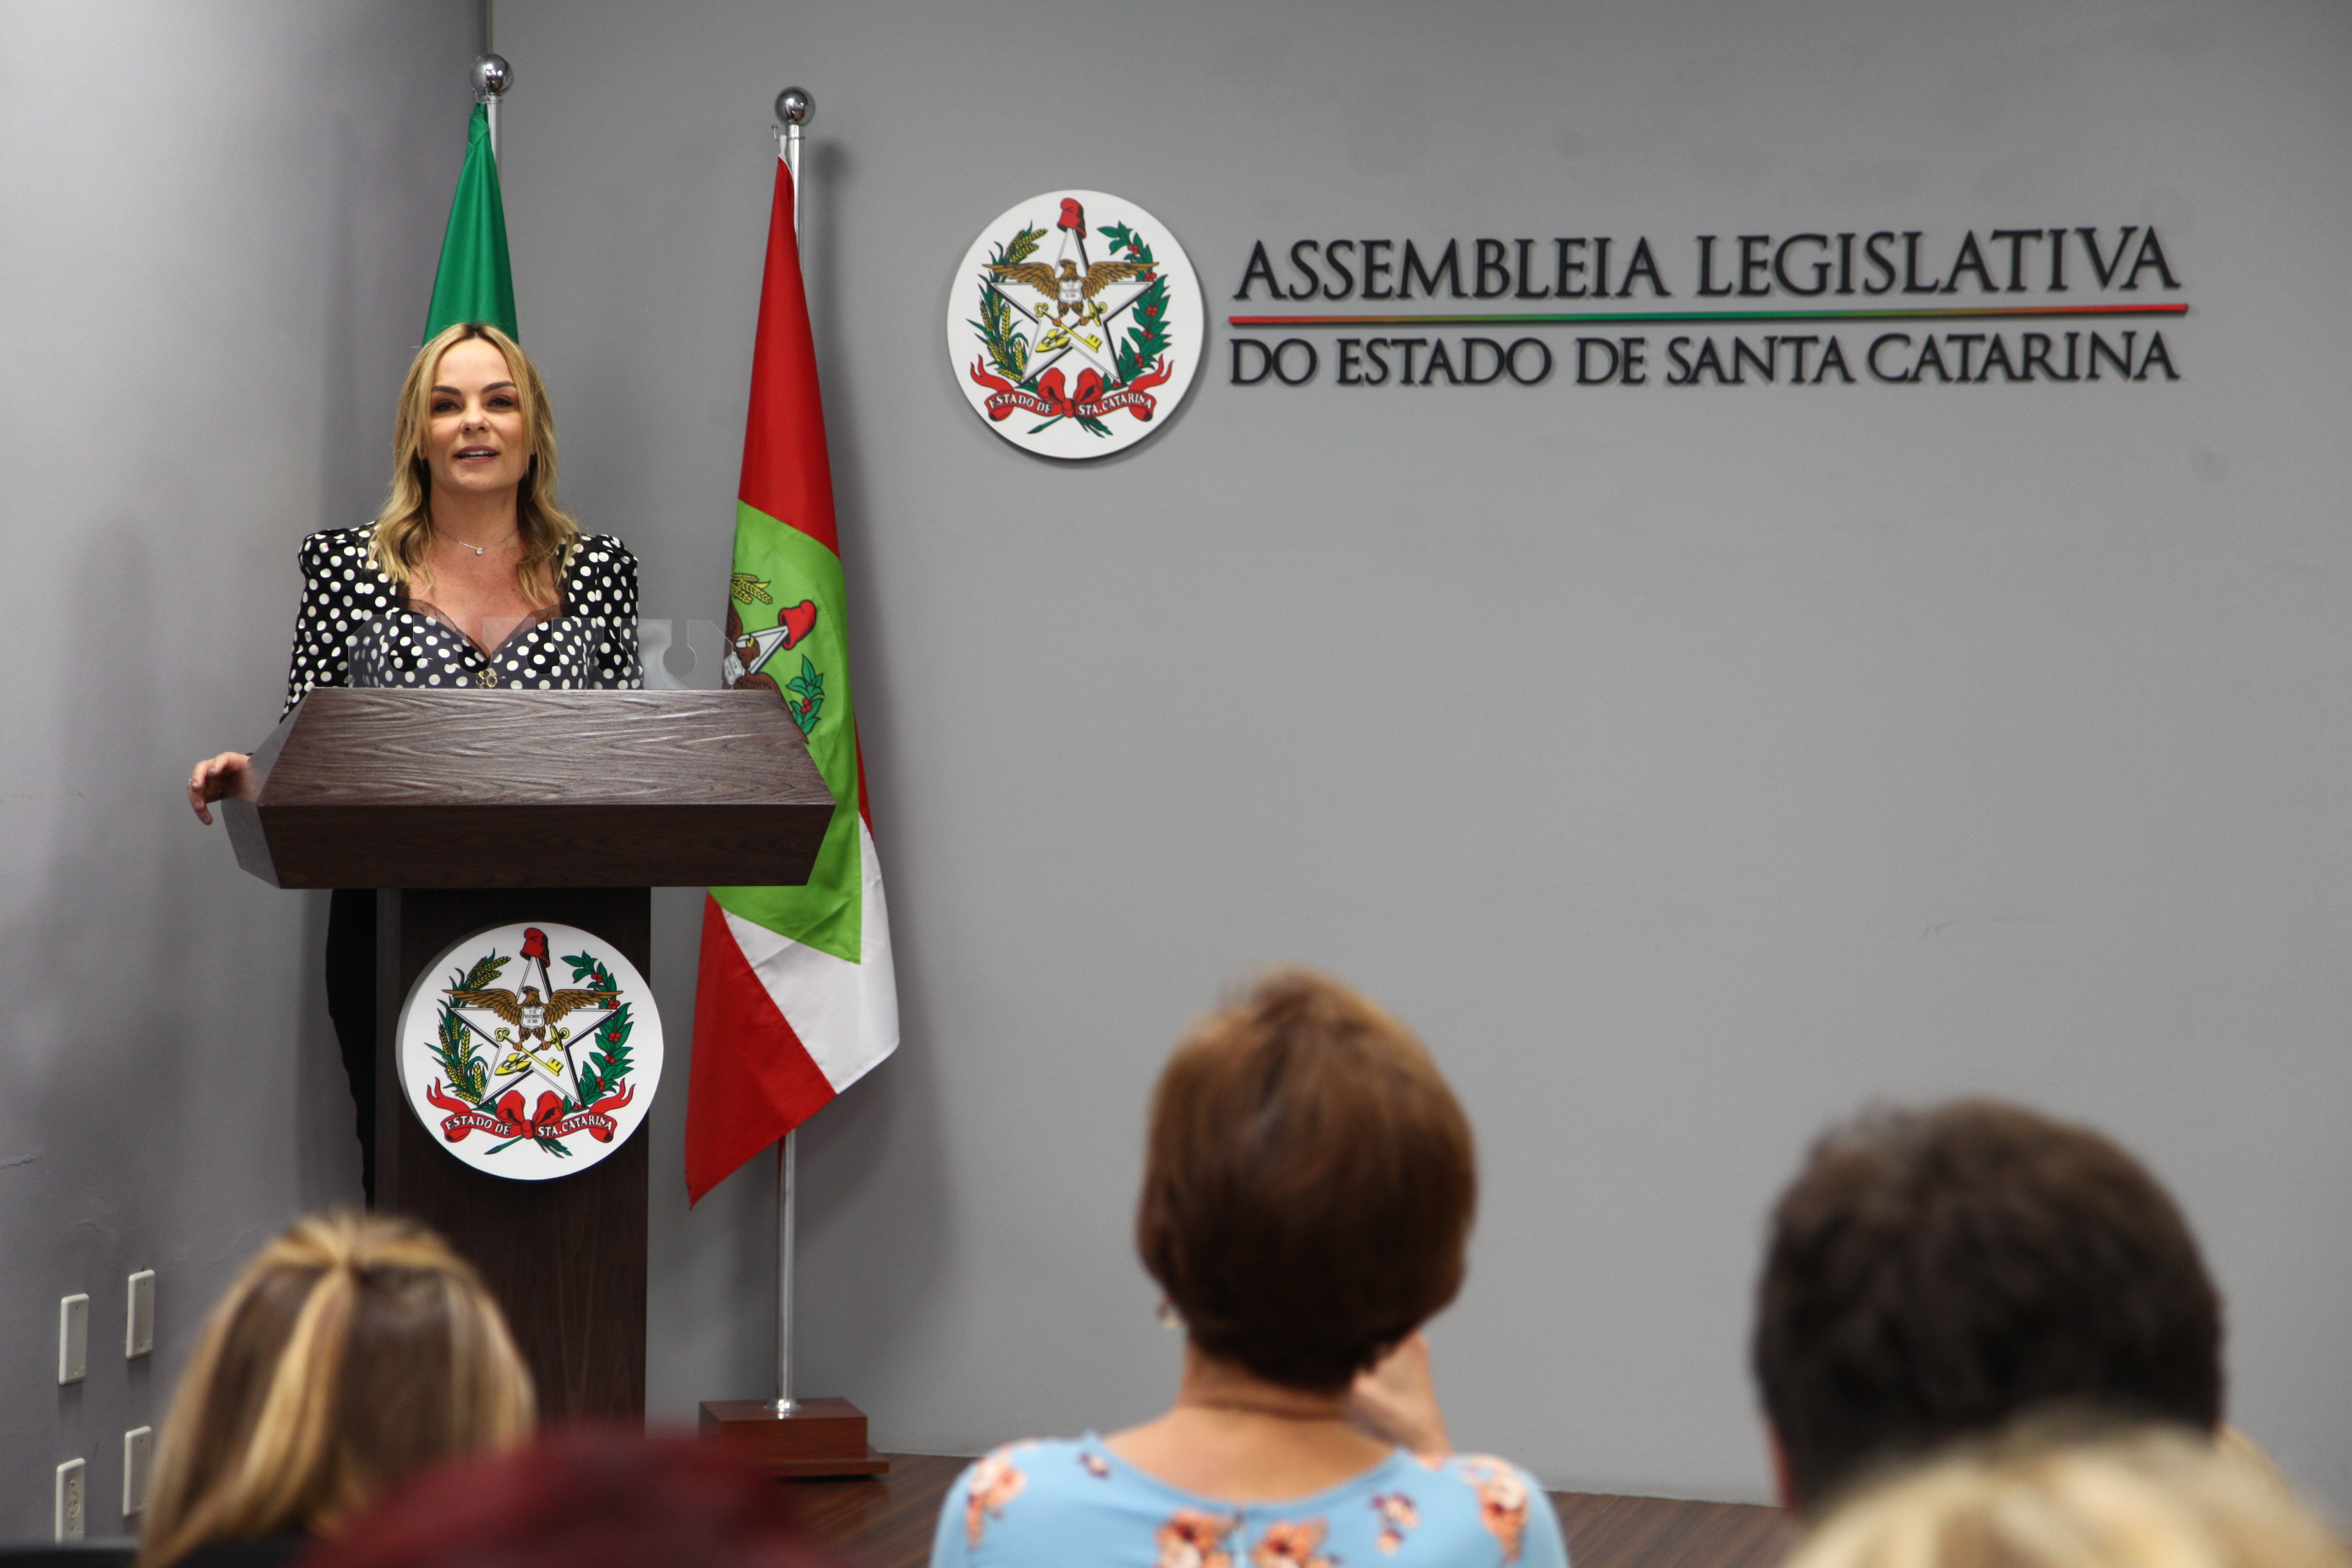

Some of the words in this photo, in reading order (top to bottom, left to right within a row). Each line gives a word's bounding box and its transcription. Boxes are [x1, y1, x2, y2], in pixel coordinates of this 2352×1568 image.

[1233, 236, 1672, 301] ASSEMBLEIA
[1695, 225, 2181, 297] LEGISLATIVA
[1229, 337, 1318, 387] DO
[1337, 336, 1553, 386] ESTADO
[1576, 336, 1647, 386] DE
[1667, 335, 1856, 386] SANTA
[1867, 329, 2180, 384] CATARINA
[988, 393, 1034, 409] ESTADO
[1036, 401, 1053, 415] DE
[444, 1114, 493, 1130] ESTADO
[494, 1123, 511, 1135] DE
